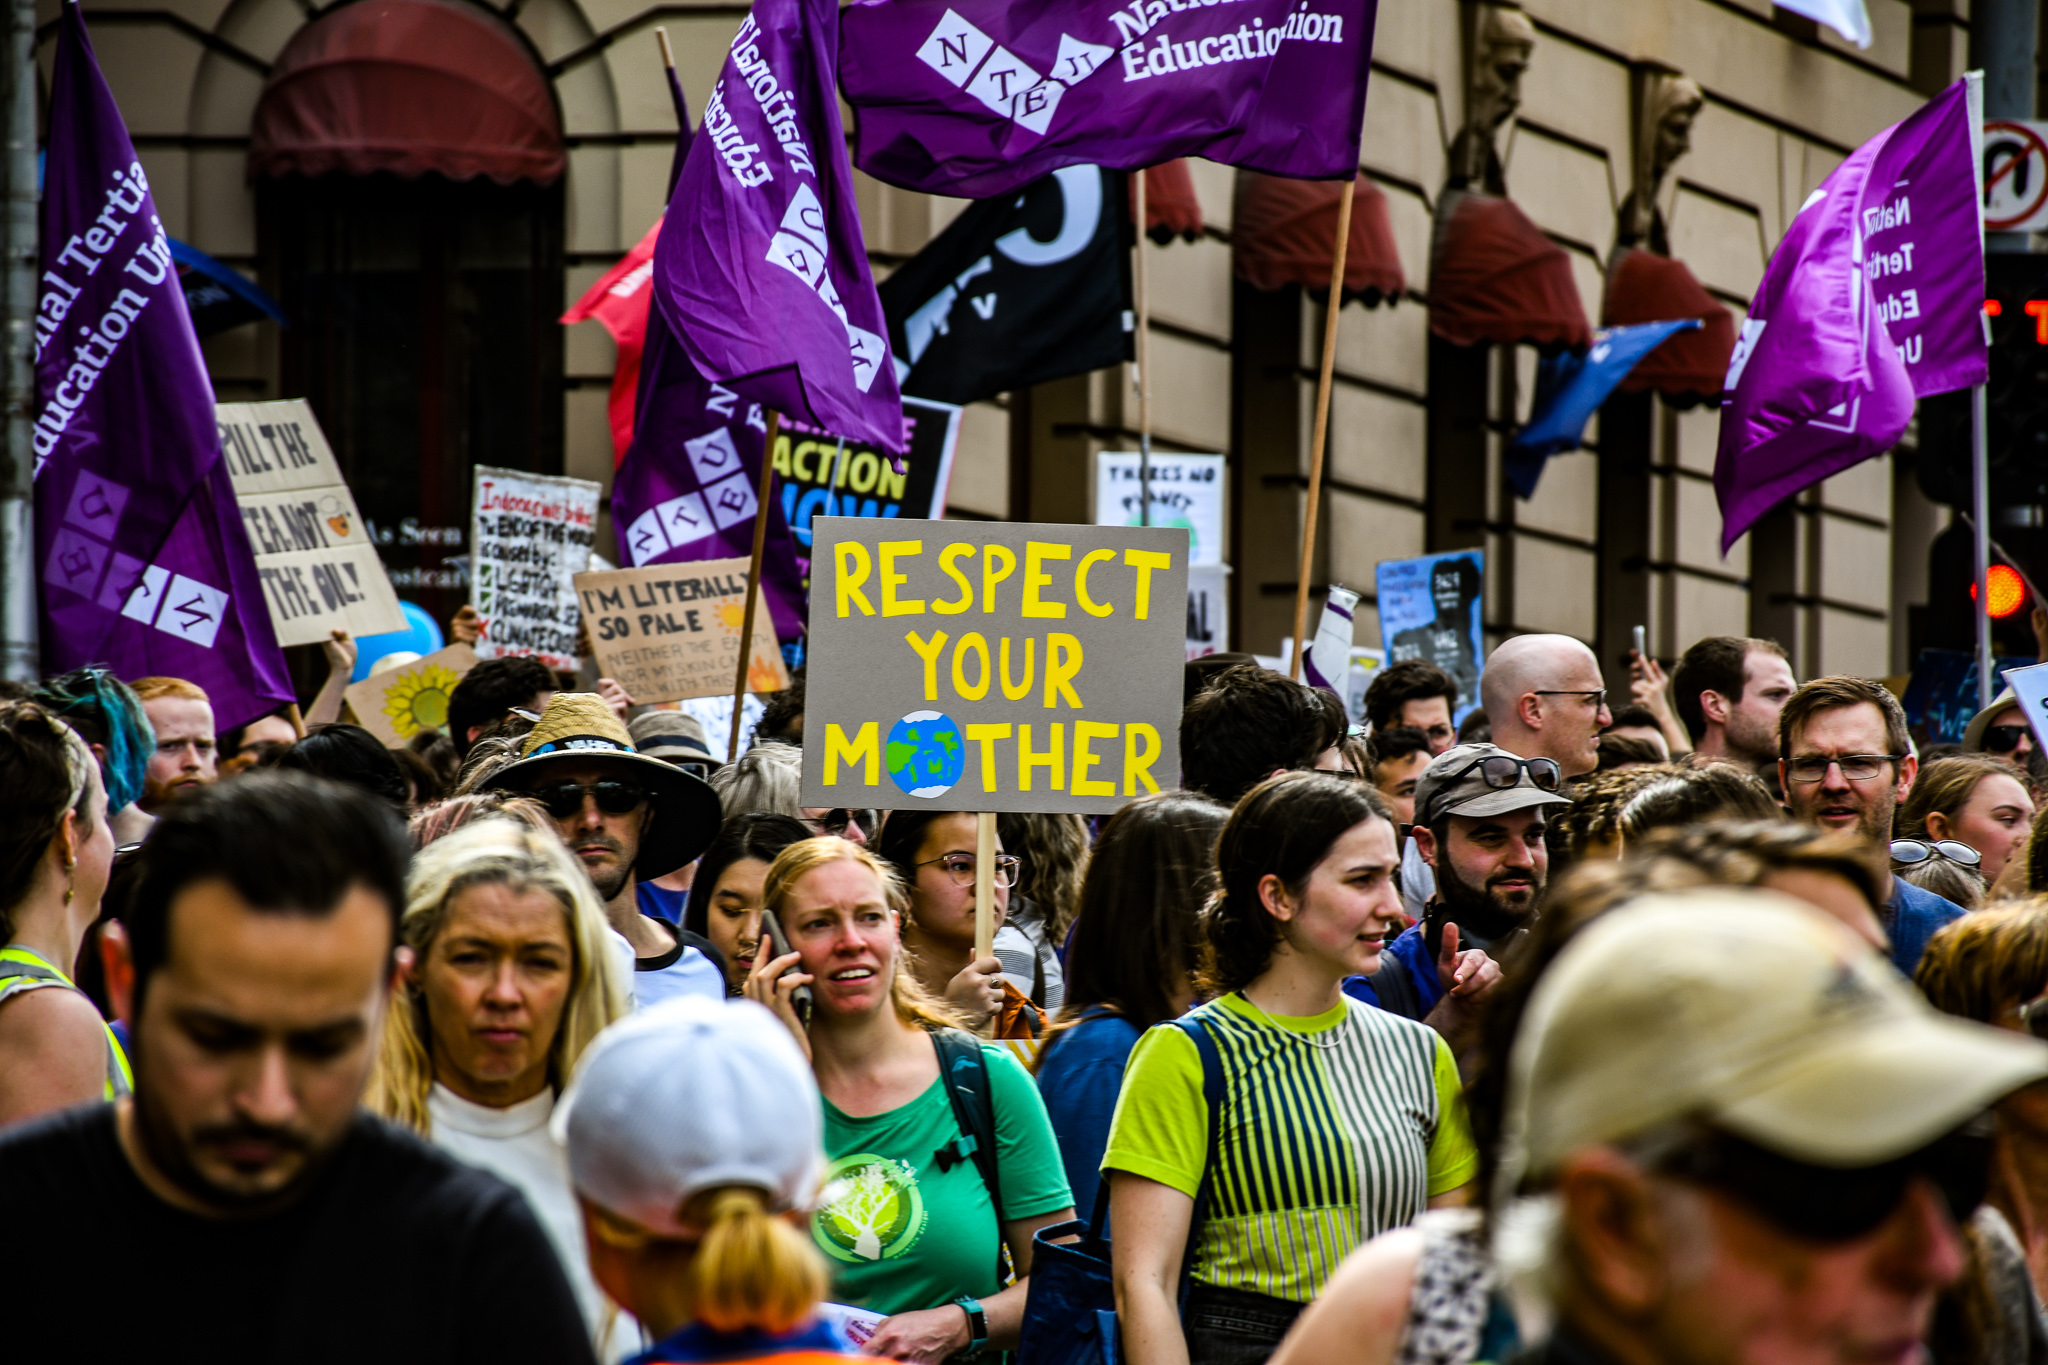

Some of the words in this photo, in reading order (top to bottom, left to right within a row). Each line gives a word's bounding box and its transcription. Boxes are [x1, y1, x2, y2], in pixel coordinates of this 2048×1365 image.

[1121, 17, 1282, 82] Educatio
[1281, 1, 1343, 43] nion
[57, 160, 149, 276] Tertia
[124, 214, 171, 285] Uni
[217, 421, 273, 476] PILL
[259, 421, 317, 469] THE
[772, 435, 909, 499] ACTION
[582, 585, 625, 614] I'M
[834, 540, 1171, 620] RESPECT
[598, 616, 629, 640] SO
[638, 610, 703, 636] PALE
[607, 643, 684, 666] NEITHER
[721, 634, 770, 651] EATH
[613, 667, 649, 683] NOR
[676, 659, 715, 675] SKIN
[626, 683, 655, 697] EAL
[657, 677, 699, 692] WITH
[904, 629, 1083, 708] YOUR
